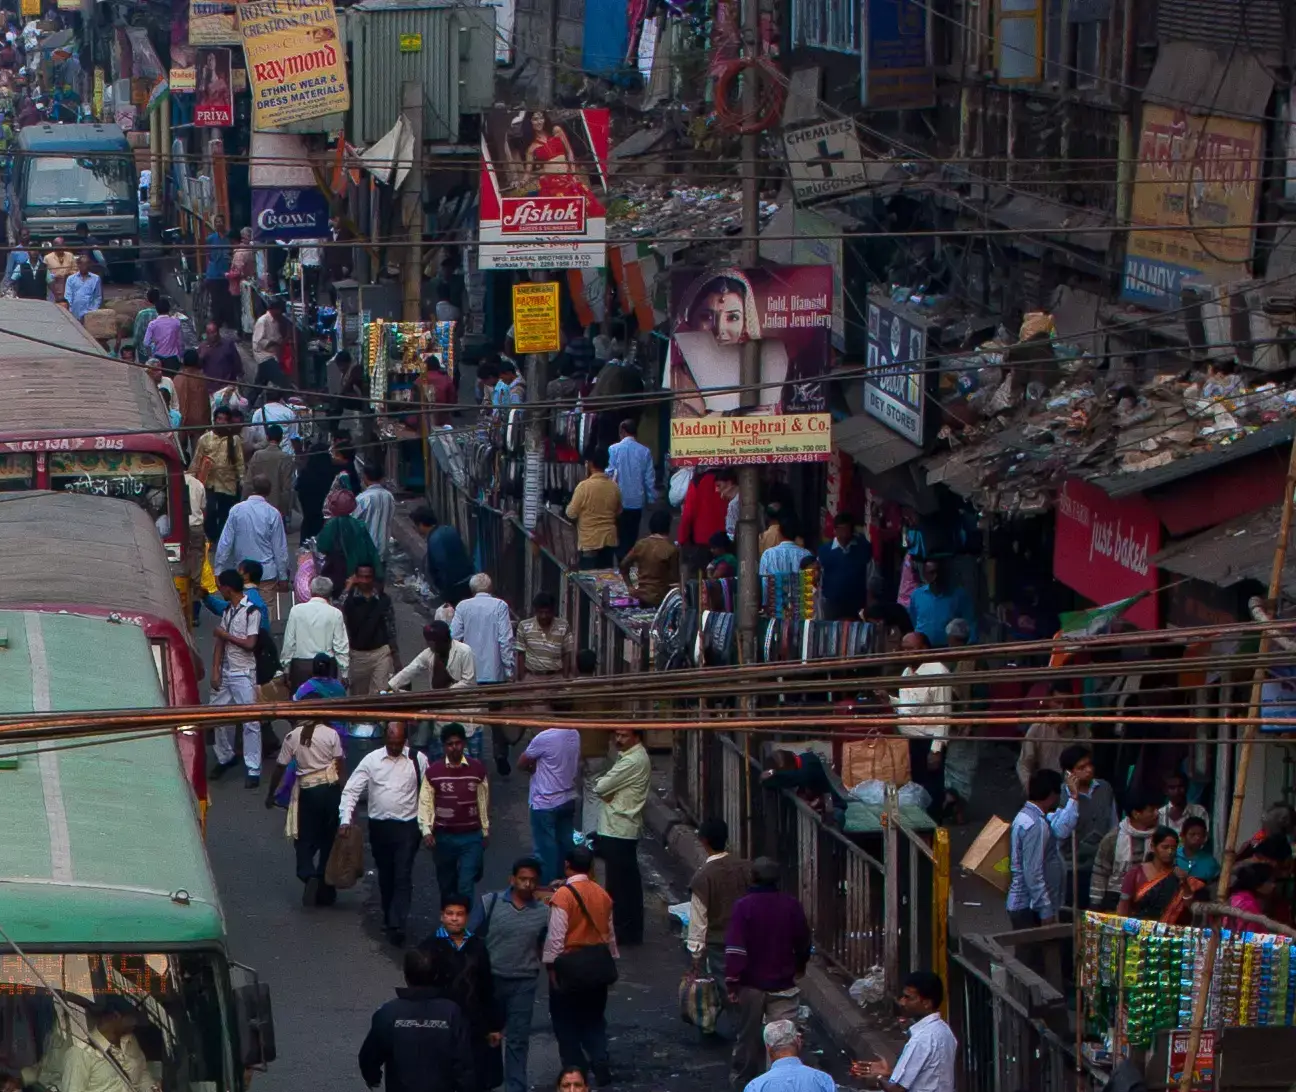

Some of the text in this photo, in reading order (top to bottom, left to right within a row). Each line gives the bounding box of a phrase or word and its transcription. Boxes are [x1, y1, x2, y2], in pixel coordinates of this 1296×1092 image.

[242, 15, 298, 38] CREATIONS
[254, 44, 337, 84] Raymond
[257, 84, 345, 110] DRESS MATERIALS
[261, 74, 337, 98] ETHNIC WEAR &
[197, 109, 229, 122] PRIYA
[786, 121, 853, 145] CHEMISTS
[797, 174, 863, 197] DRUGGISTS
[258, 209, 316, 230] CROWN
[503, 200, 578, 226] Ashok
[767, 294, 827, 312] Gold, Diamond
[790, 313, 832, 330] Jewellery
[870, 393, 916, 432] DEY STORES
[672, 416, 830, 438] Madanji Meghraj & Co.
[94, 436, 124, 449] Bus
[686, 448, 716, 456] Armenian
[775, 445, 799, 453] Kolkata
[730, 436, 771, 447] Jewellers
[1089, 513, 1150, 576] just baked
